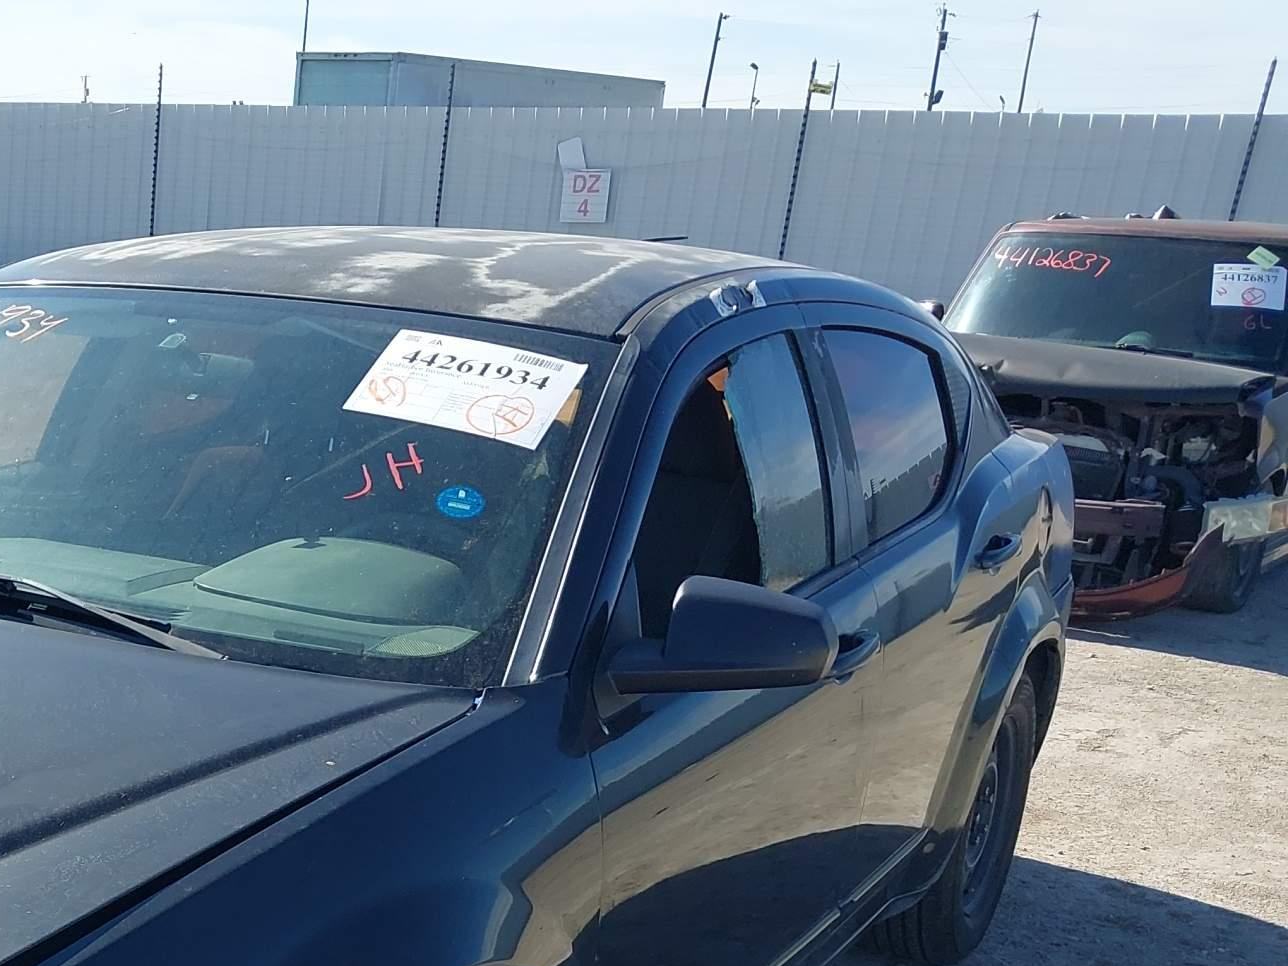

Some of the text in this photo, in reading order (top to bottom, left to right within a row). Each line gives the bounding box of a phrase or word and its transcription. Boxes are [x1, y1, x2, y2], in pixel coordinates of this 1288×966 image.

[572, 174, 601, 193] DZ
[577, 198, 589, 217] 4
[994, 246, 1111, 278] 44126837
[1221, 273, 1279, 284] 44126837
[401, 349, 551, 391] 44261934
